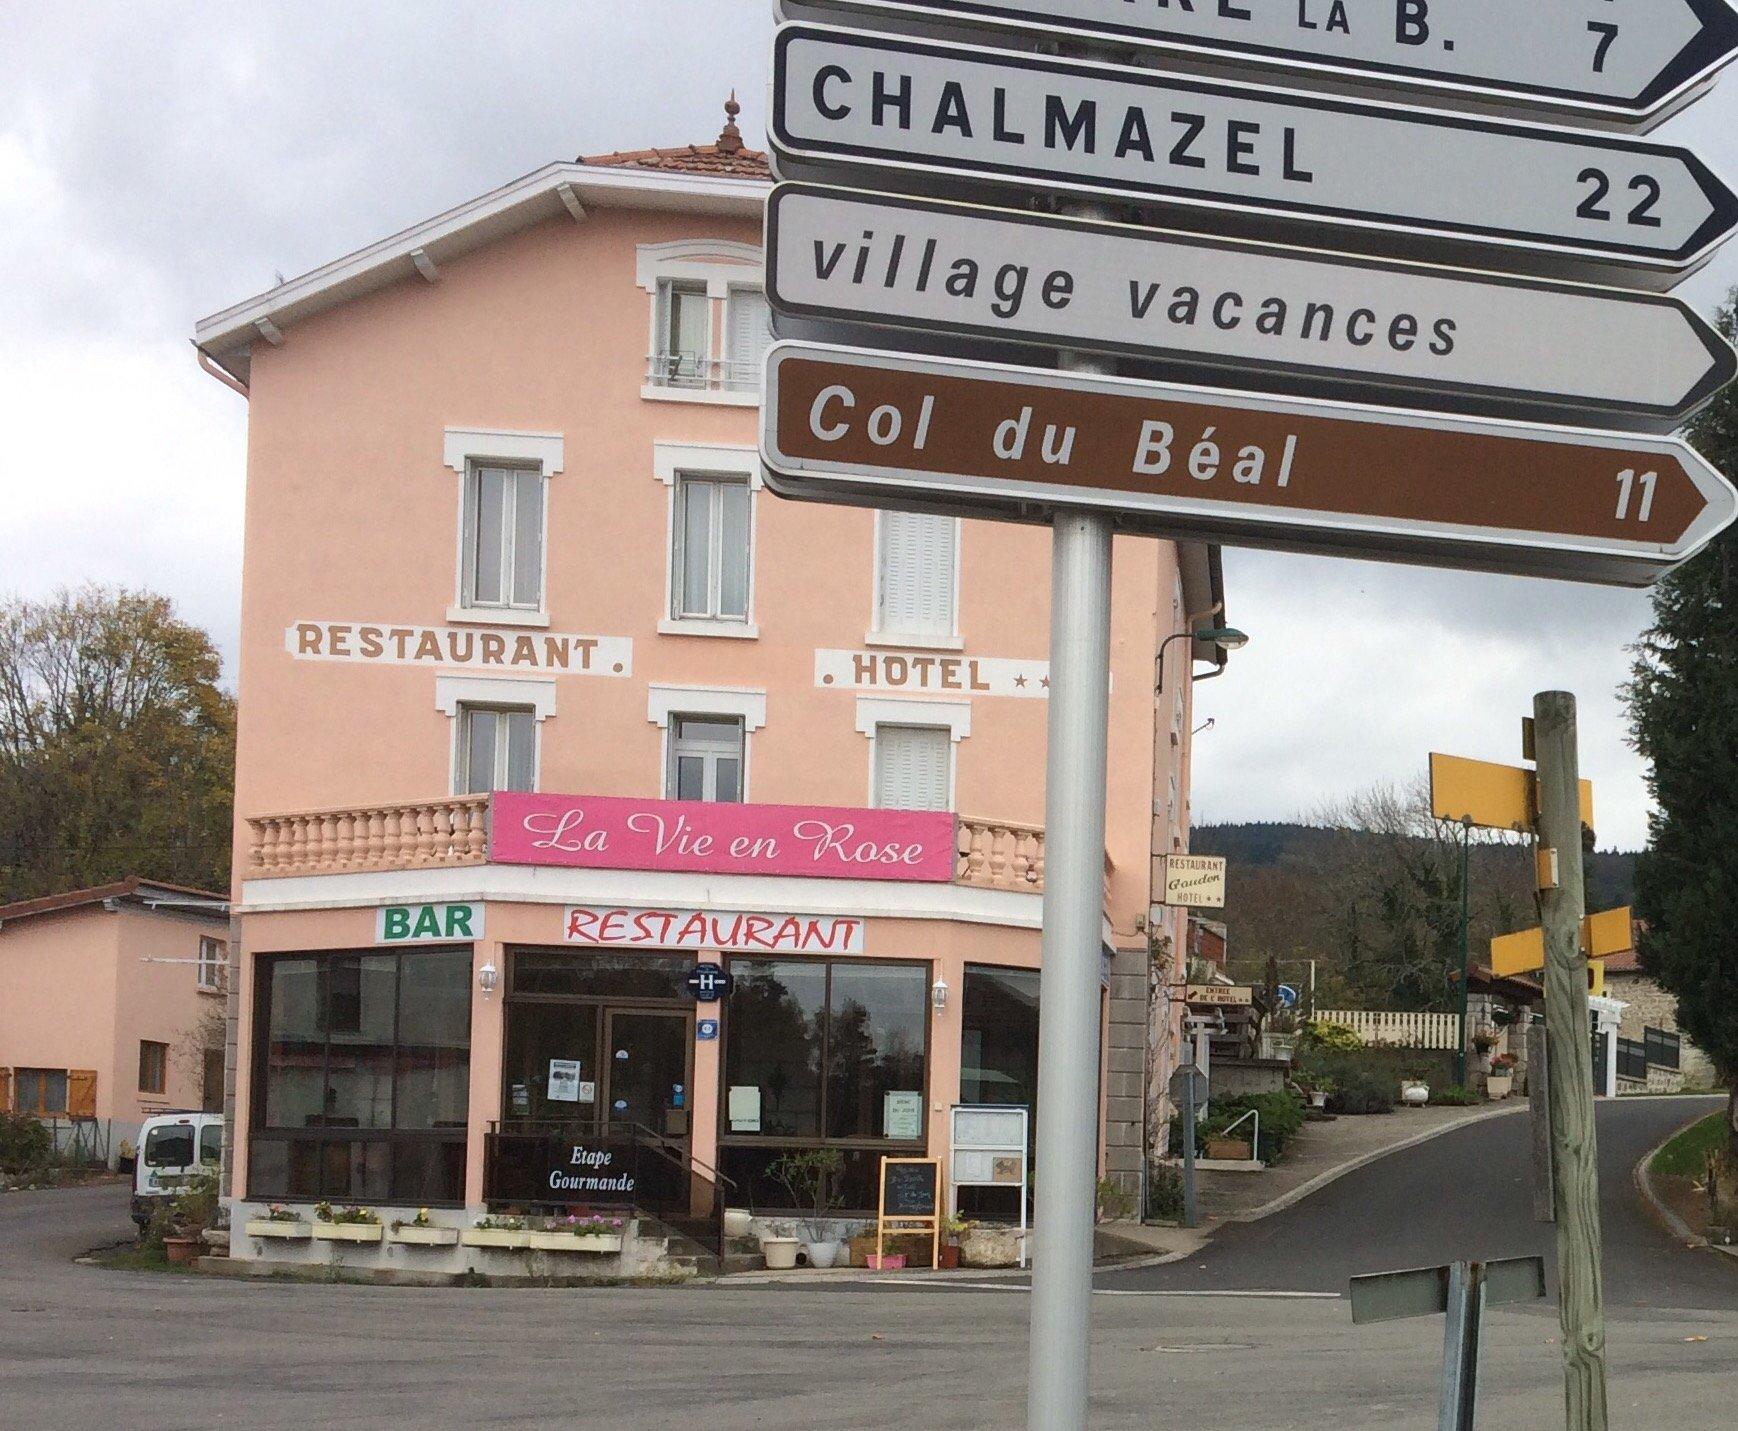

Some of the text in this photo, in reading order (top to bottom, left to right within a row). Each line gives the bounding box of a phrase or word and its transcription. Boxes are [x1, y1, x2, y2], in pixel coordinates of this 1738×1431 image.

[1299, 0, 1350, 35] LA
[1396, 0, 1454, 51] B.
[1587, 20, 1619, 73] 7
[812, 64, 1662, 228] CHALMAZEL 22
[813, 230, 1458, 356] village vacances
[808, 384, 1658, 523] Col du Béal 11
[296, 623, 599, 670] RESTAURANT
[852, 654, 990, 691] HOTEL
[523, 808, 924, 866] La Vie en Rose
[1169, 858, 1223, 872] RESTAURANT
[1177, 892, 1203, 904] HOTEL
[383, 905, 474, 940] BAR
[567, 909, 861, 952] RESTAURANT
[570, 1146, 613, 1169] Etape
[549, 1169, 636, 1192] Gourmande
